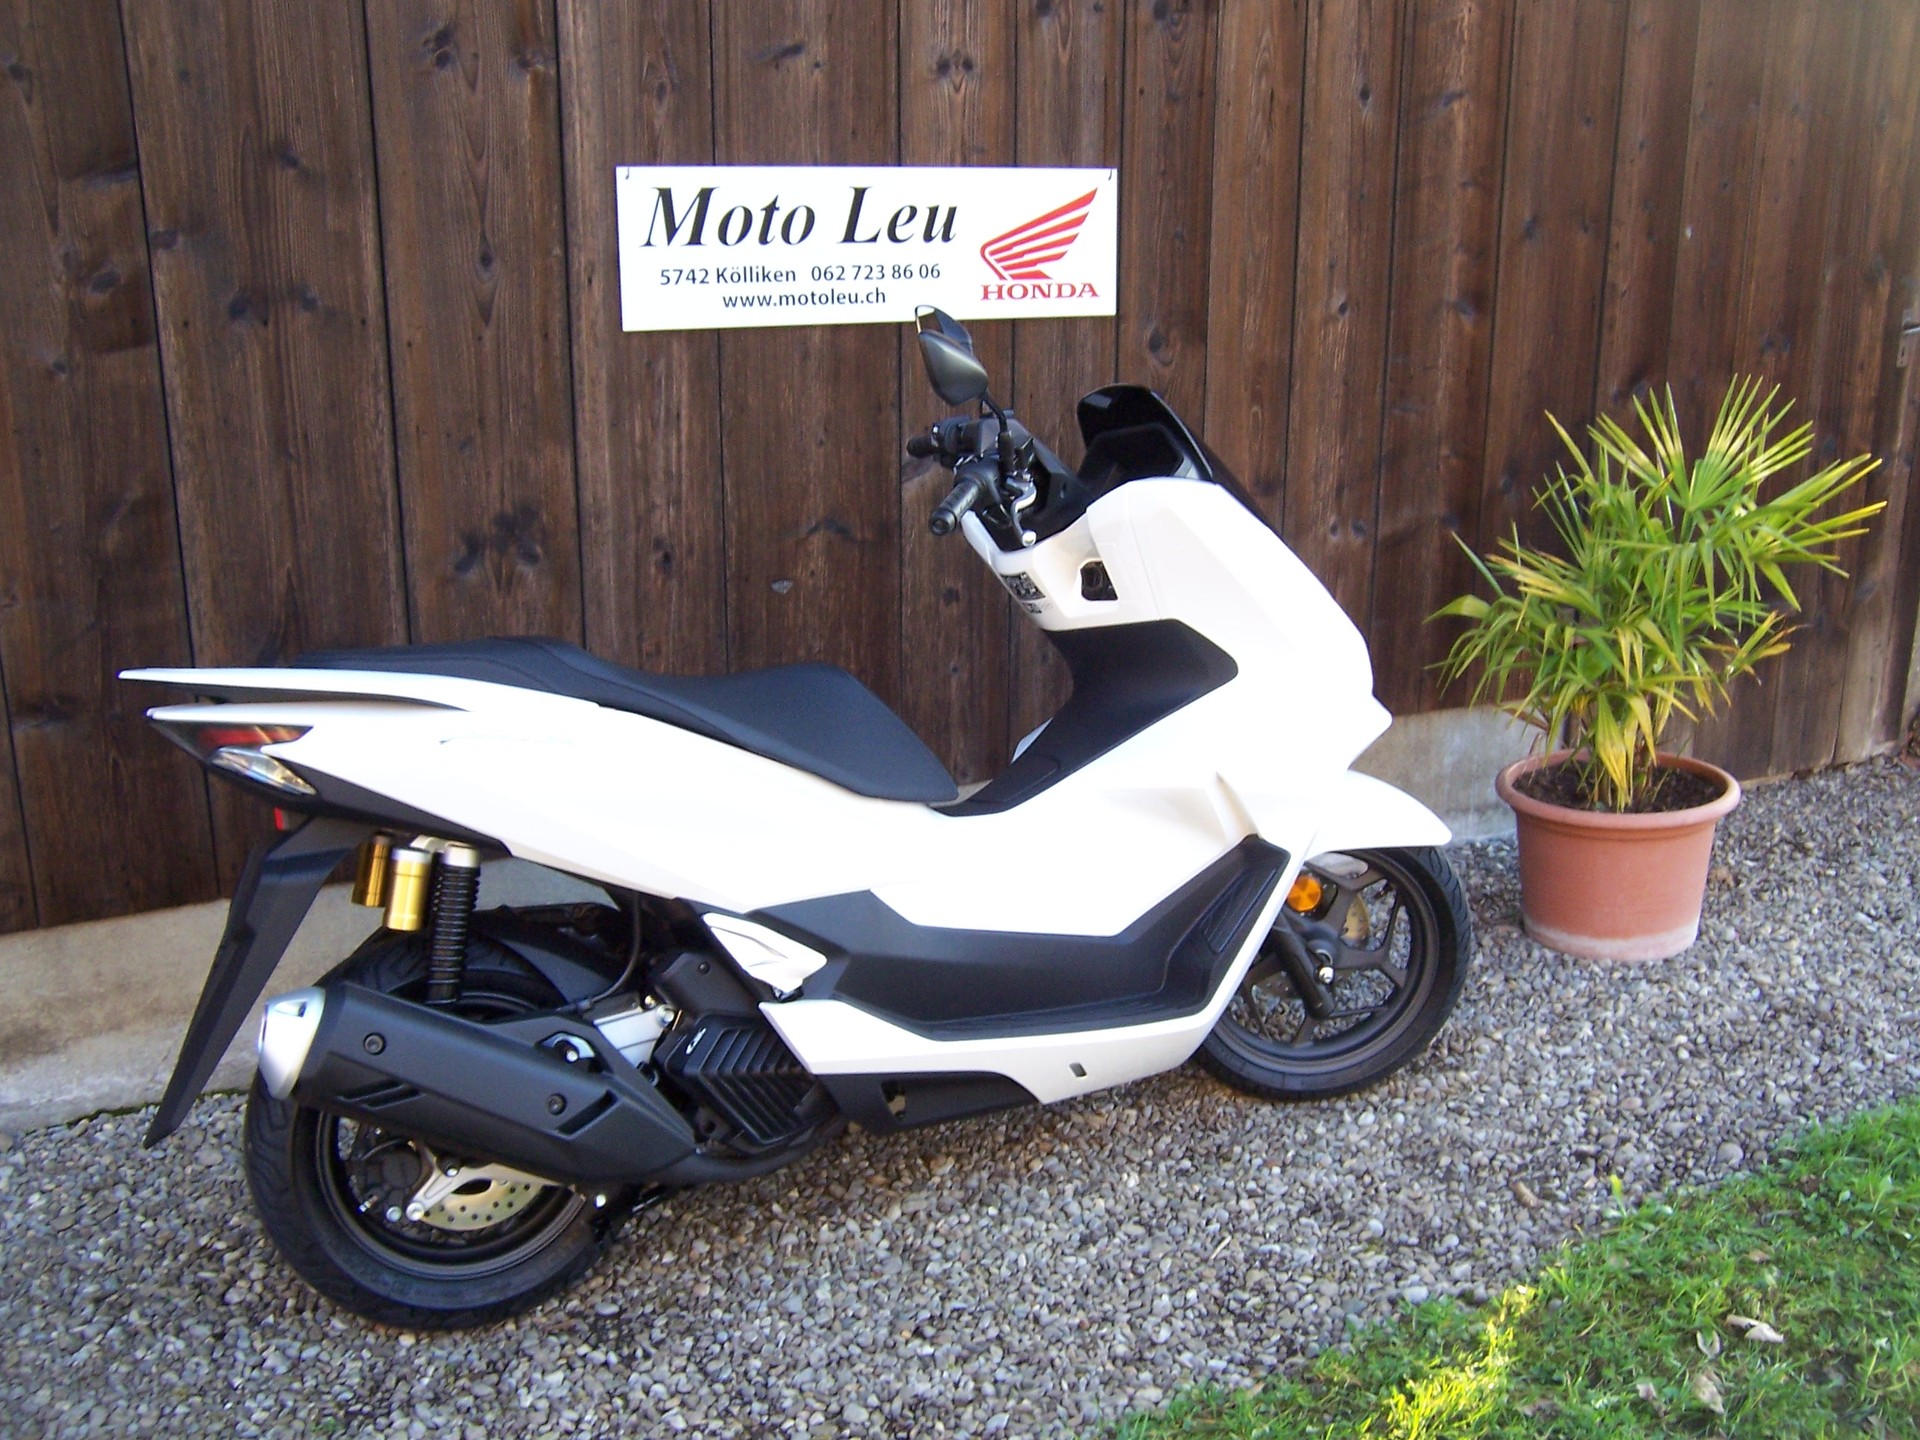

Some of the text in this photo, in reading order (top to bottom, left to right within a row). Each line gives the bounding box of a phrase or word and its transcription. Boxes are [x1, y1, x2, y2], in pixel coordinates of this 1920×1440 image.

[639, 186, 959, 247] Moto Leu
[660, 263, 941, 285] 5742 Kölliken 062 723 86 06
[722, 287, 886, 308] www.motoleu.ch
[980, 281, 1100, 301] HONDA
